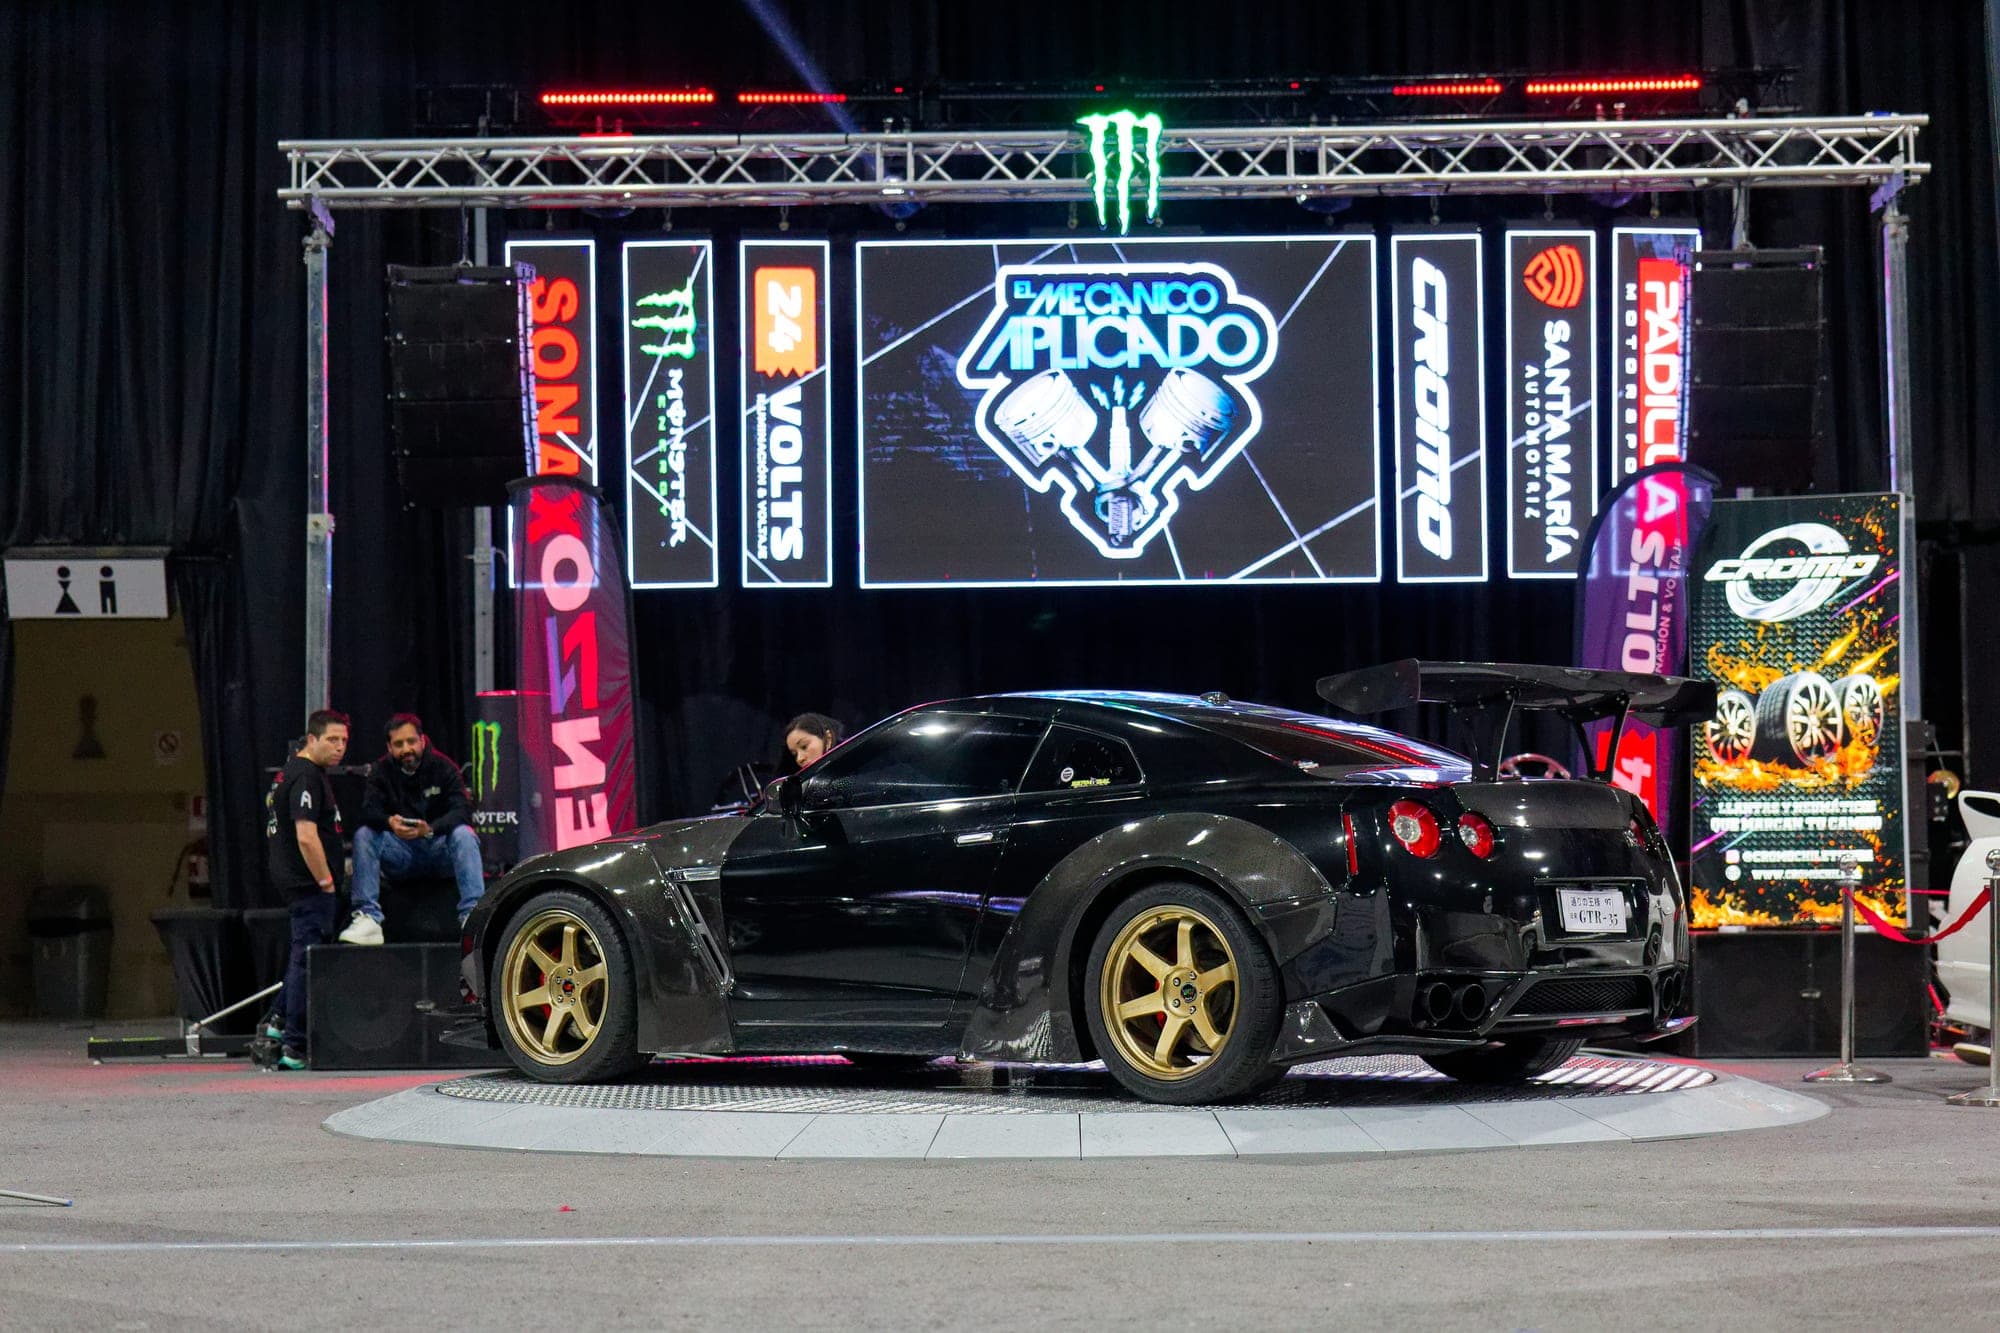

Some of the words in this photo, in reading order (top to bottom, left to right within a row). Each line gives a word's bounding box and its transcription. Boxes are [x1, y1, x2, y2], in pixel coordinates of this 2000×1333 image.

[767, 280, 802, 353] 24
[1014, 281, 1035, 299] EL
[1026, 281, 1219, 316] MECANICO
[976, 313, 1260, 371] APLICADO
[1411, 257, 1452, 560] CROMO
[665, 367, 688, 548] MONSTER
[1525, 364, 1541, 519] AUTOMOTRIZ
[756, 487, 768, 499] &
[769, 385, 804, 561] VOLTS
[756, 500, 768, 560] VOLTAJE
[1704, 554, 1881, 582] CROMO
[1621, 528, 1666, 674] OLTS
[1662, 600, 1673, 613] &
[1611, 757, 1652, 808] 4
[1805, 817, 1827, 830] TU
[1579, 910, 1619, 926] GTR-35
